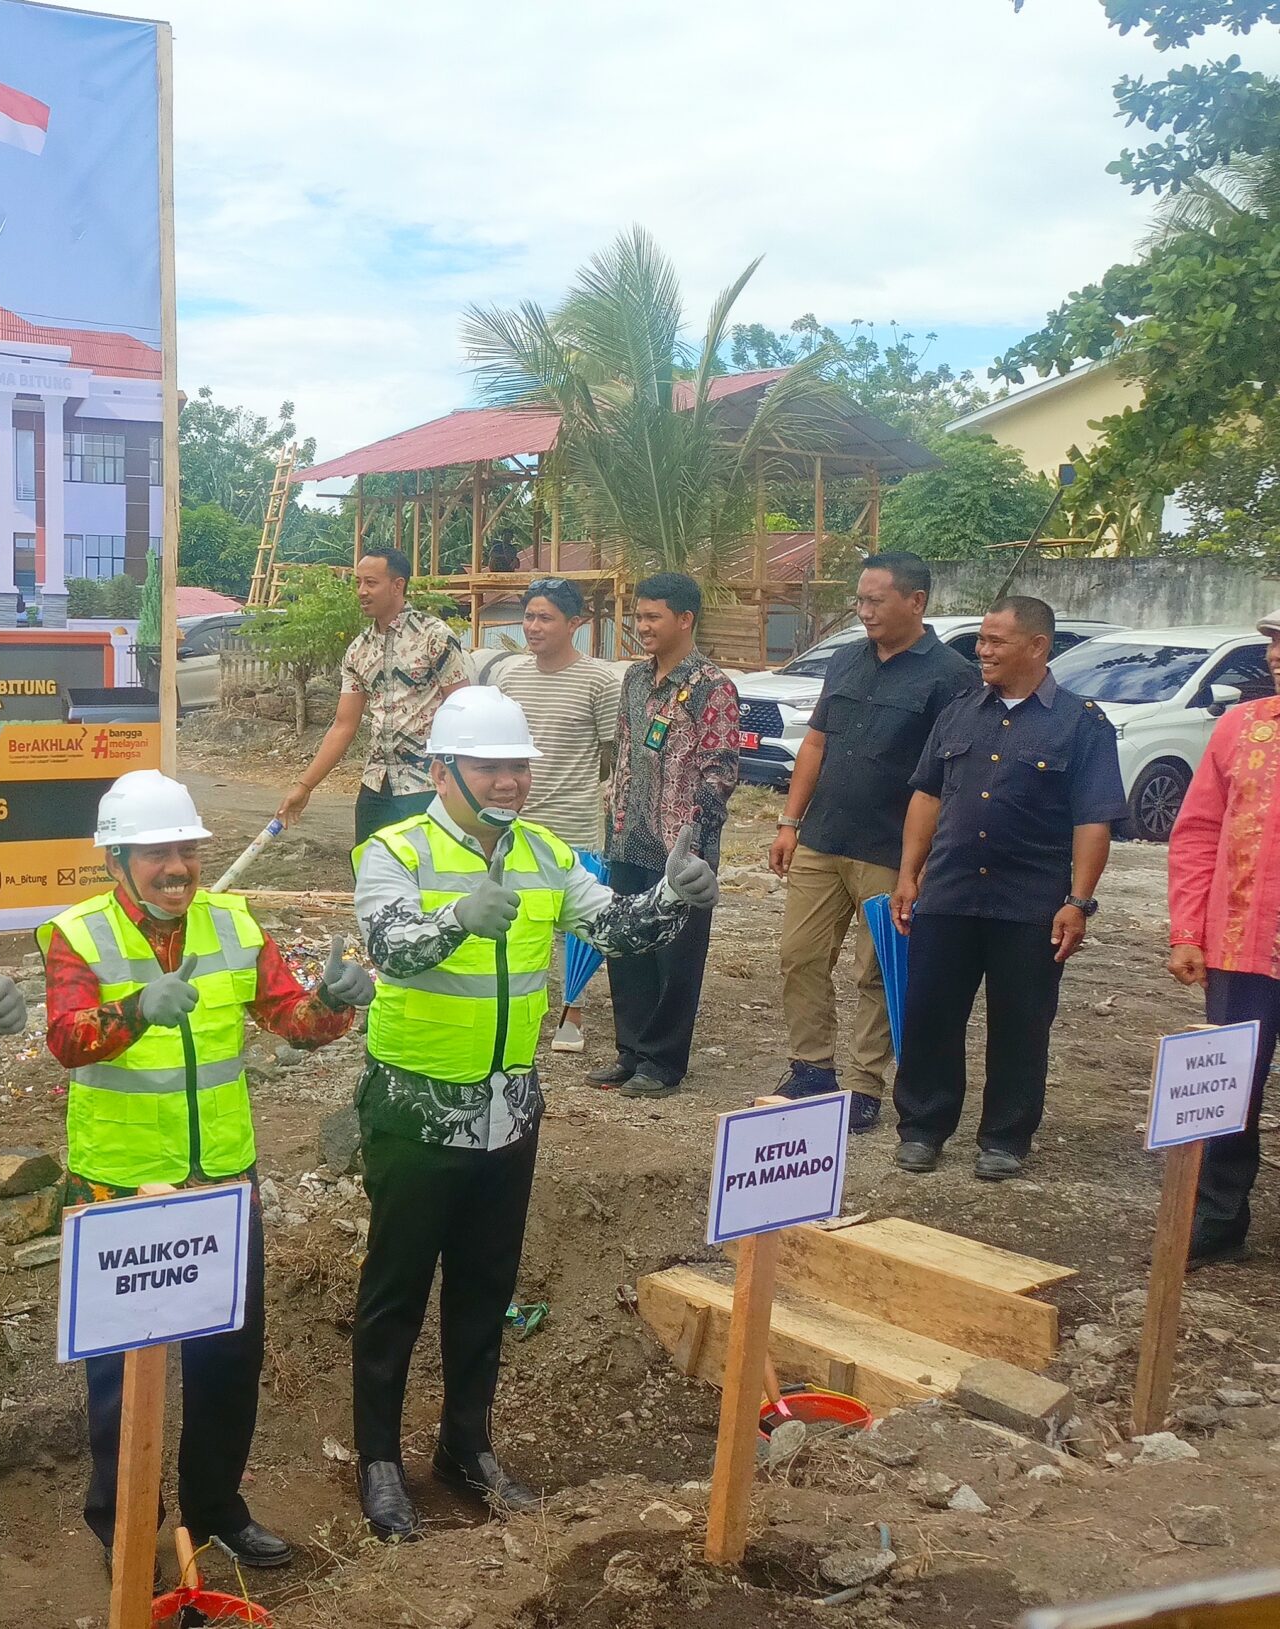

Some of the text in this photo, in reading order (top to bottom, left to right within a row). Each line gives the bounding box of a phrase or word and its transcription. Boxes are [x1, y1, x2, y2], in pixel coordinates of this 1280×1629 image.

[19, 374, 72, 390] BITUNG
[109, 729, 142, 739] bangga
[9, 738, 83, 753] BerAKHLAK
[109, 738, 148, 749] melayani
[109, 749, 141, 759] bangsa
[5, 873, 47, 885] PA_Bitung
[1185, 1052, 1227, 1070] WAKIL
[1169, 1077, 1237, 1100] WALIKOTA
[1176, 1105, 1225, 1125] BITUNG
[754, 1138, 807, 1164] KETUA
[725, 1155, 834, 1192] PTA MANADO
[98, 1234, 219, 1271] WALIKOTA
[115, 1264, 199, 1295] BITUNG
